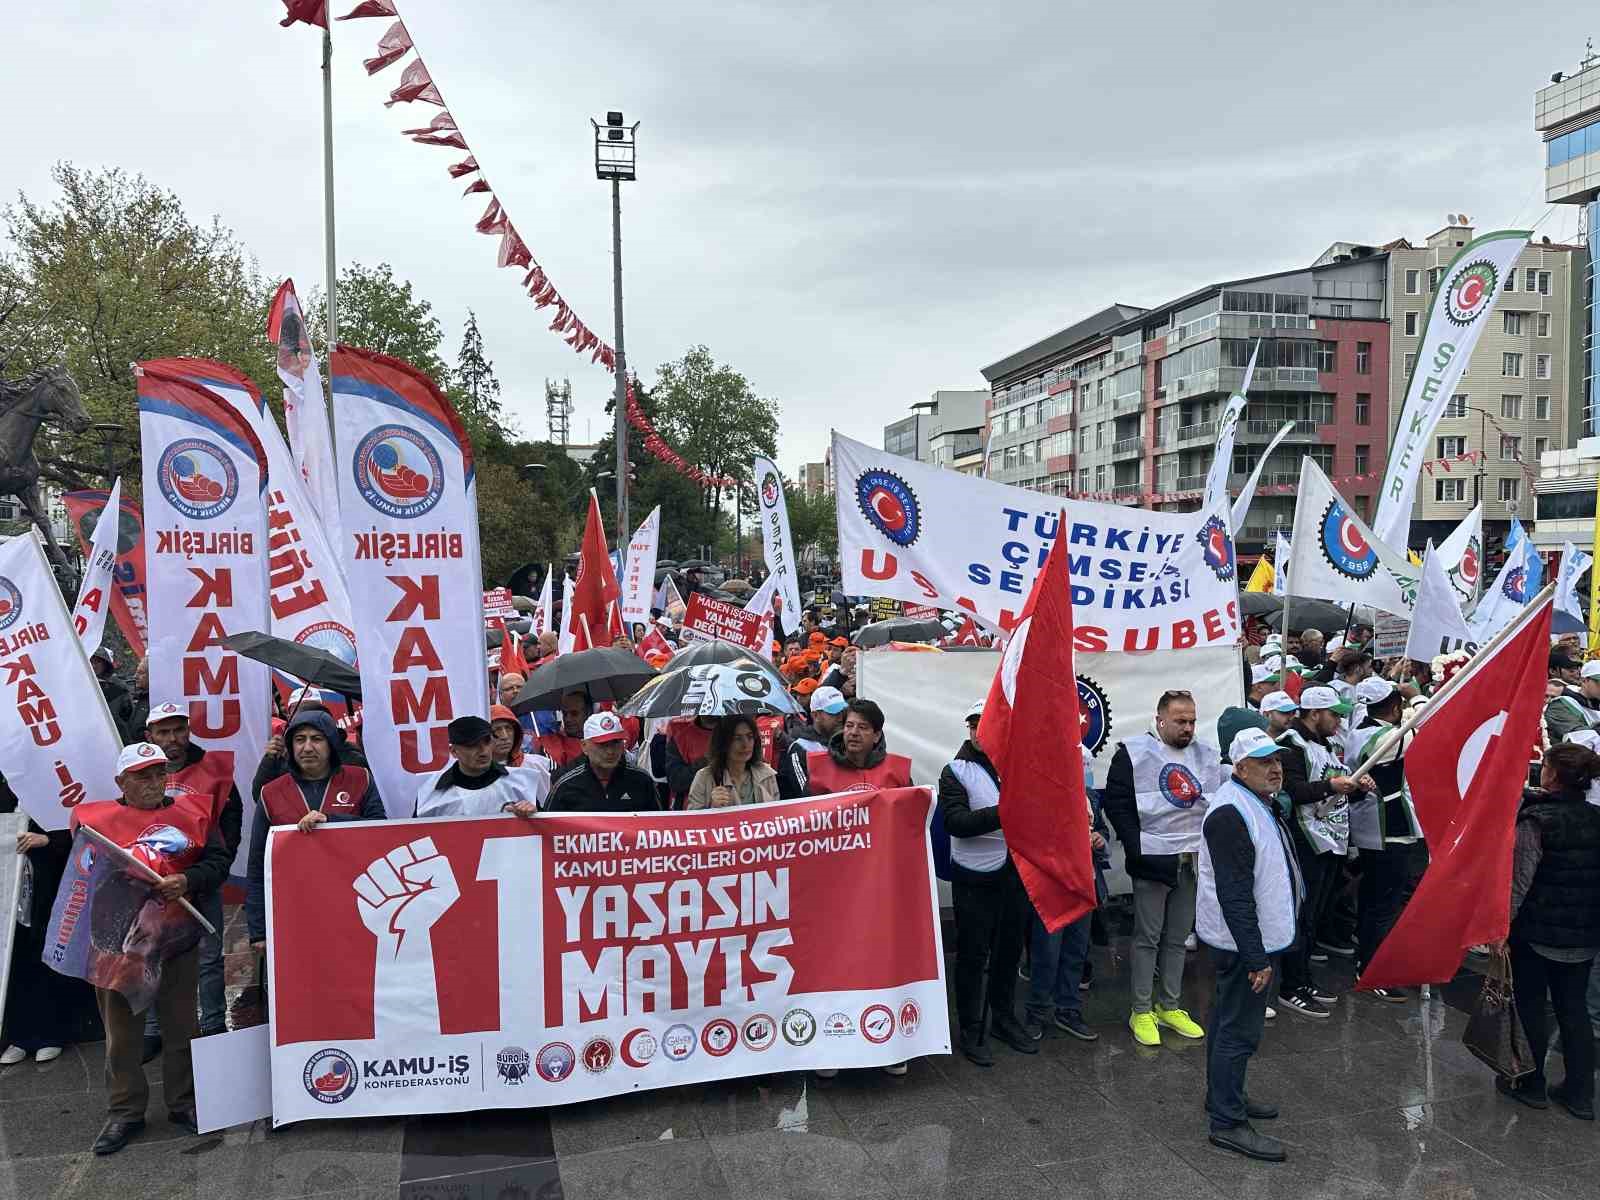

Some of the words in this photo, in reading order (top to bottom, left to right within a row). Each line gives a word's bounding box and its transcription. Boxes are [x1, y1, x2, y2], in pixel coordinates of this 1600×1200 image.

[1002, 507, 1184, 554] TÜRKİYE
[697, 596, 730, 614] MADEN
[968, 563, 1190, 609] SEDİKASI
[705, 610, 744, 632] YALNIZ
[553, 831, 630, 854] EKMEK,
[635, 828, 706, 849] ADALET
[712, 825, 736, 845] VE
[740, 808, 832, 841] ÖZGÜRLÜK
[837, 804, 870, 829] İÇİN
[553, 860, 618, 879] KAMU
[740, 842, 796, 864] OMUZ
[798, 834, 871, 858] OMUZA!
[555, 867, 791, 943] YAŞASIN
[475, 834, 546, 1032] 1
[561, 927, 797, 1026] MAYIS
[364, 1075, 470, 1090] KONFEDERASYONU
